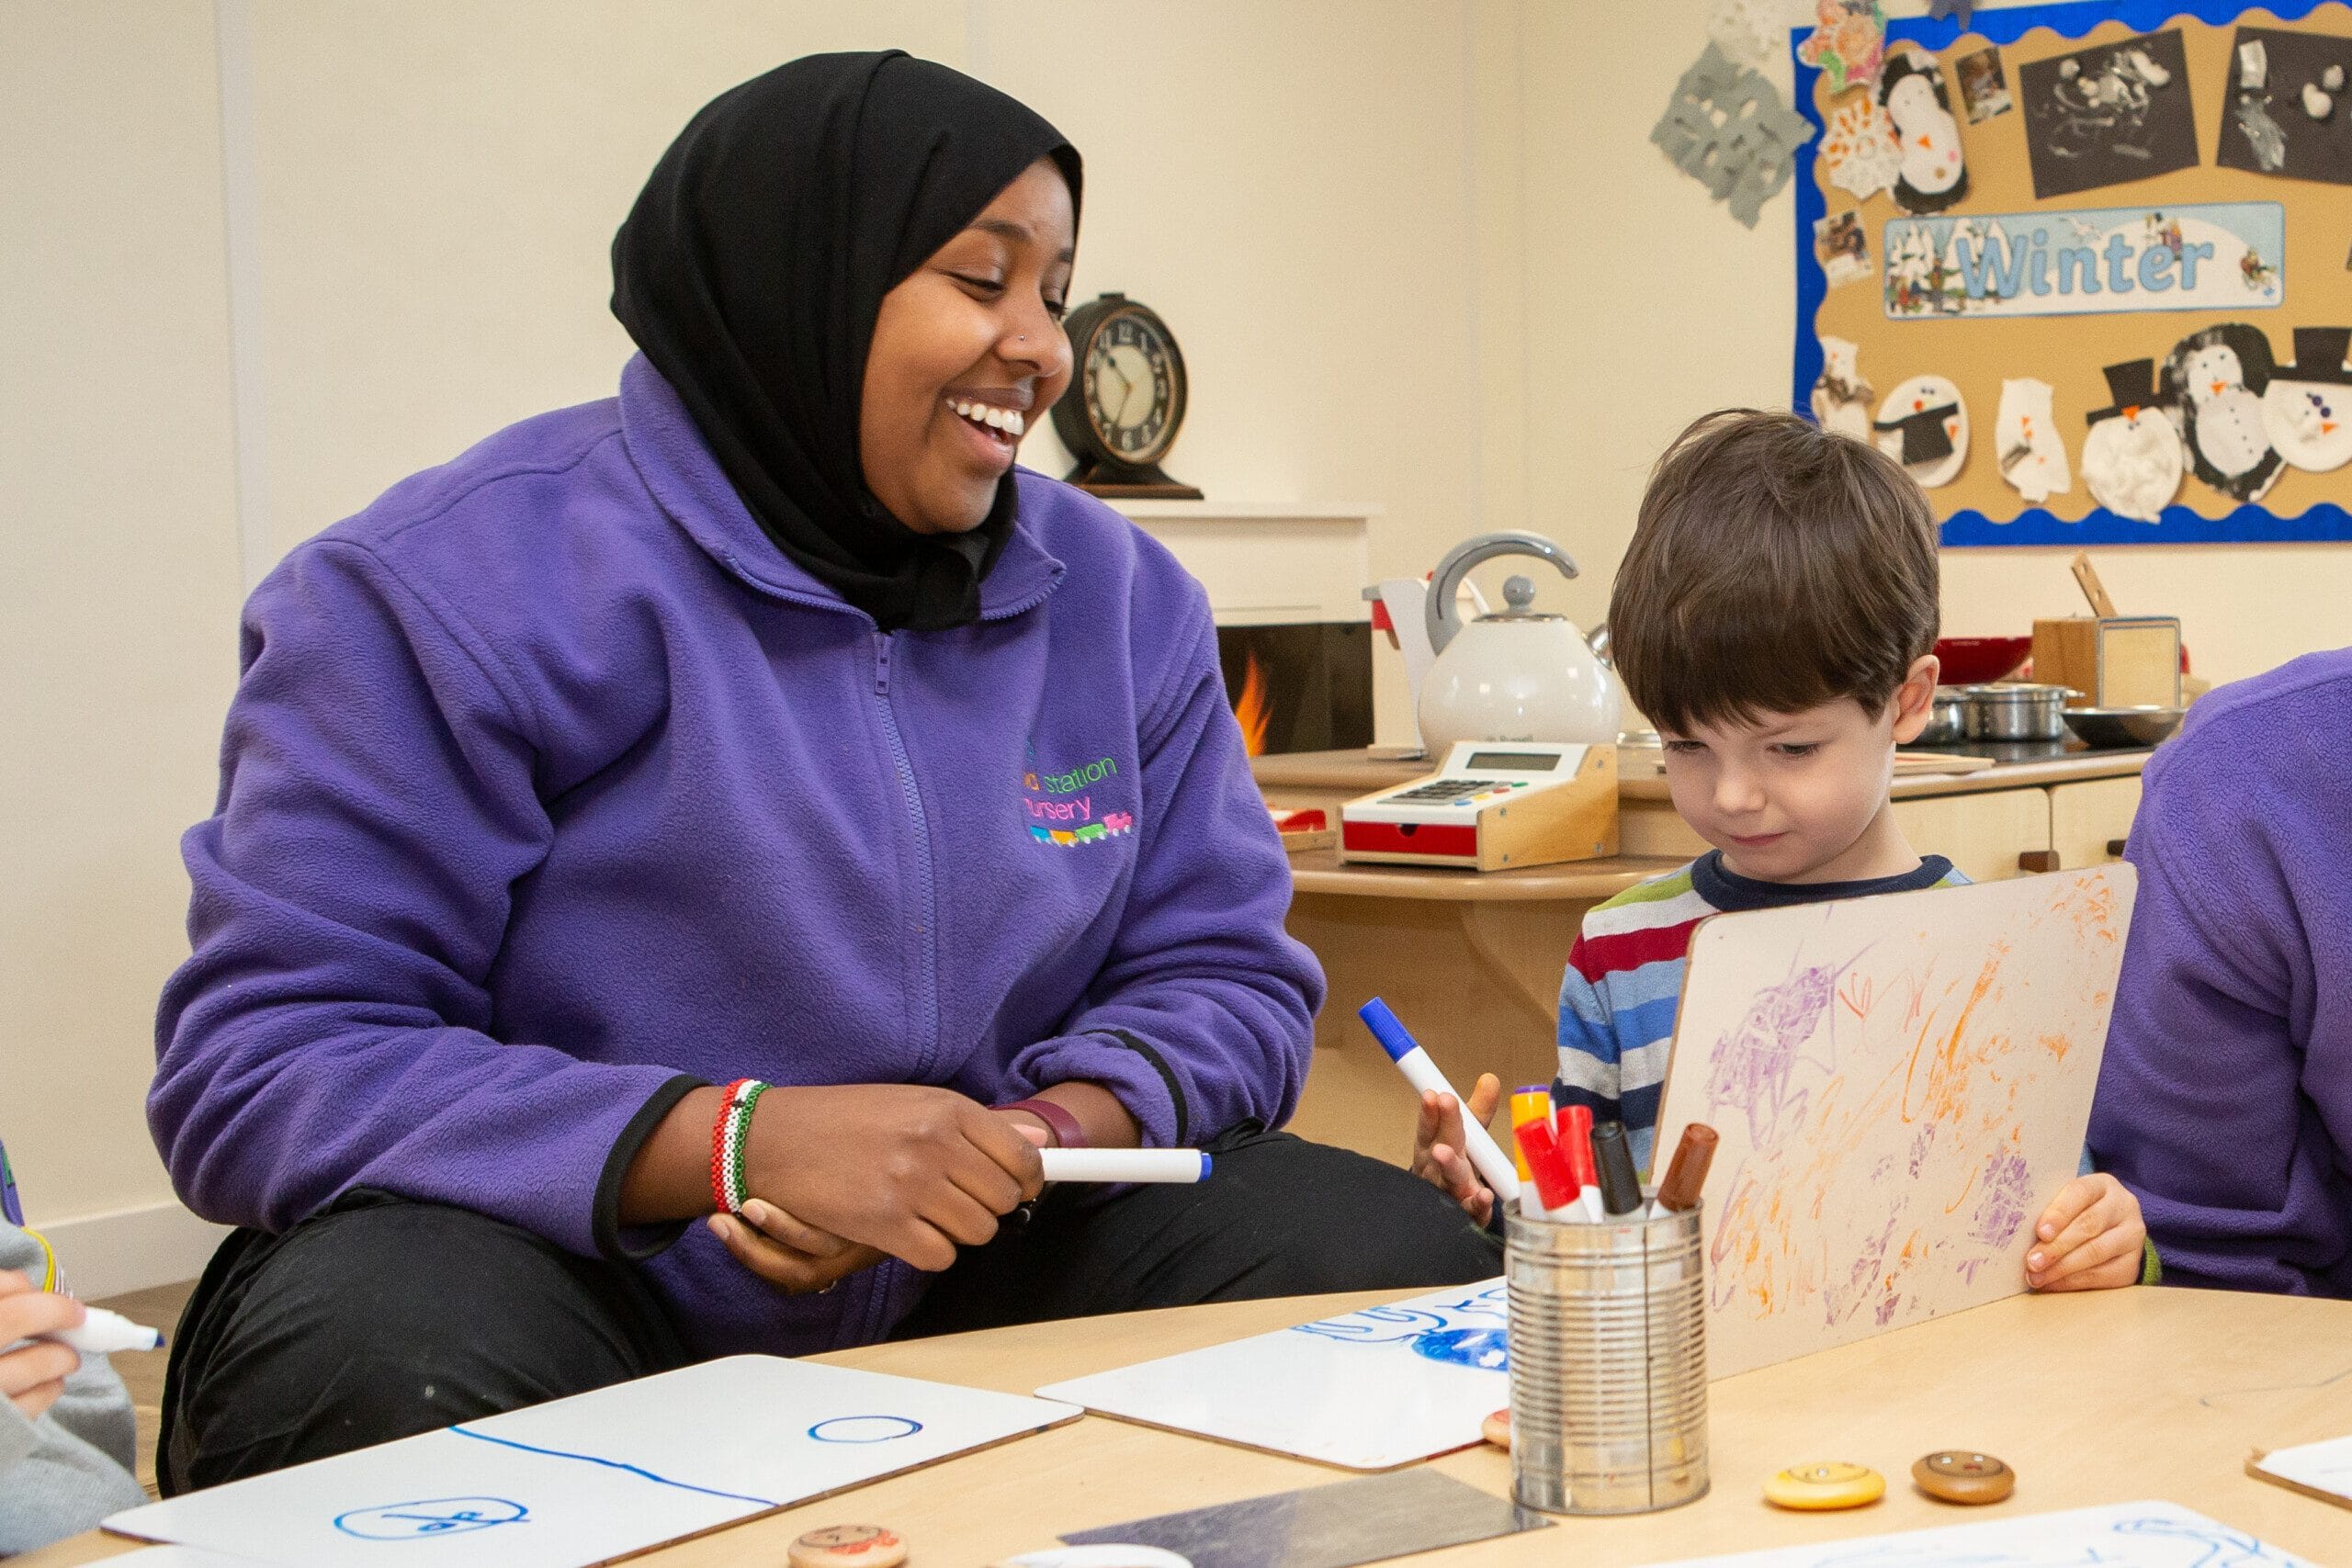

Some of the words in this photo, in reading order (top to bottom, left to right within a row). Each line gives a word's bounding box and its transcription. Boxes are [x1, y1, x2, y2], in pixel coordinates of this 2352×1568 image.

[1955, 228, 2214, 299] Winter
[1044, 757, 1117, 794] station
[1023, 795, 1091, 820] ursery
